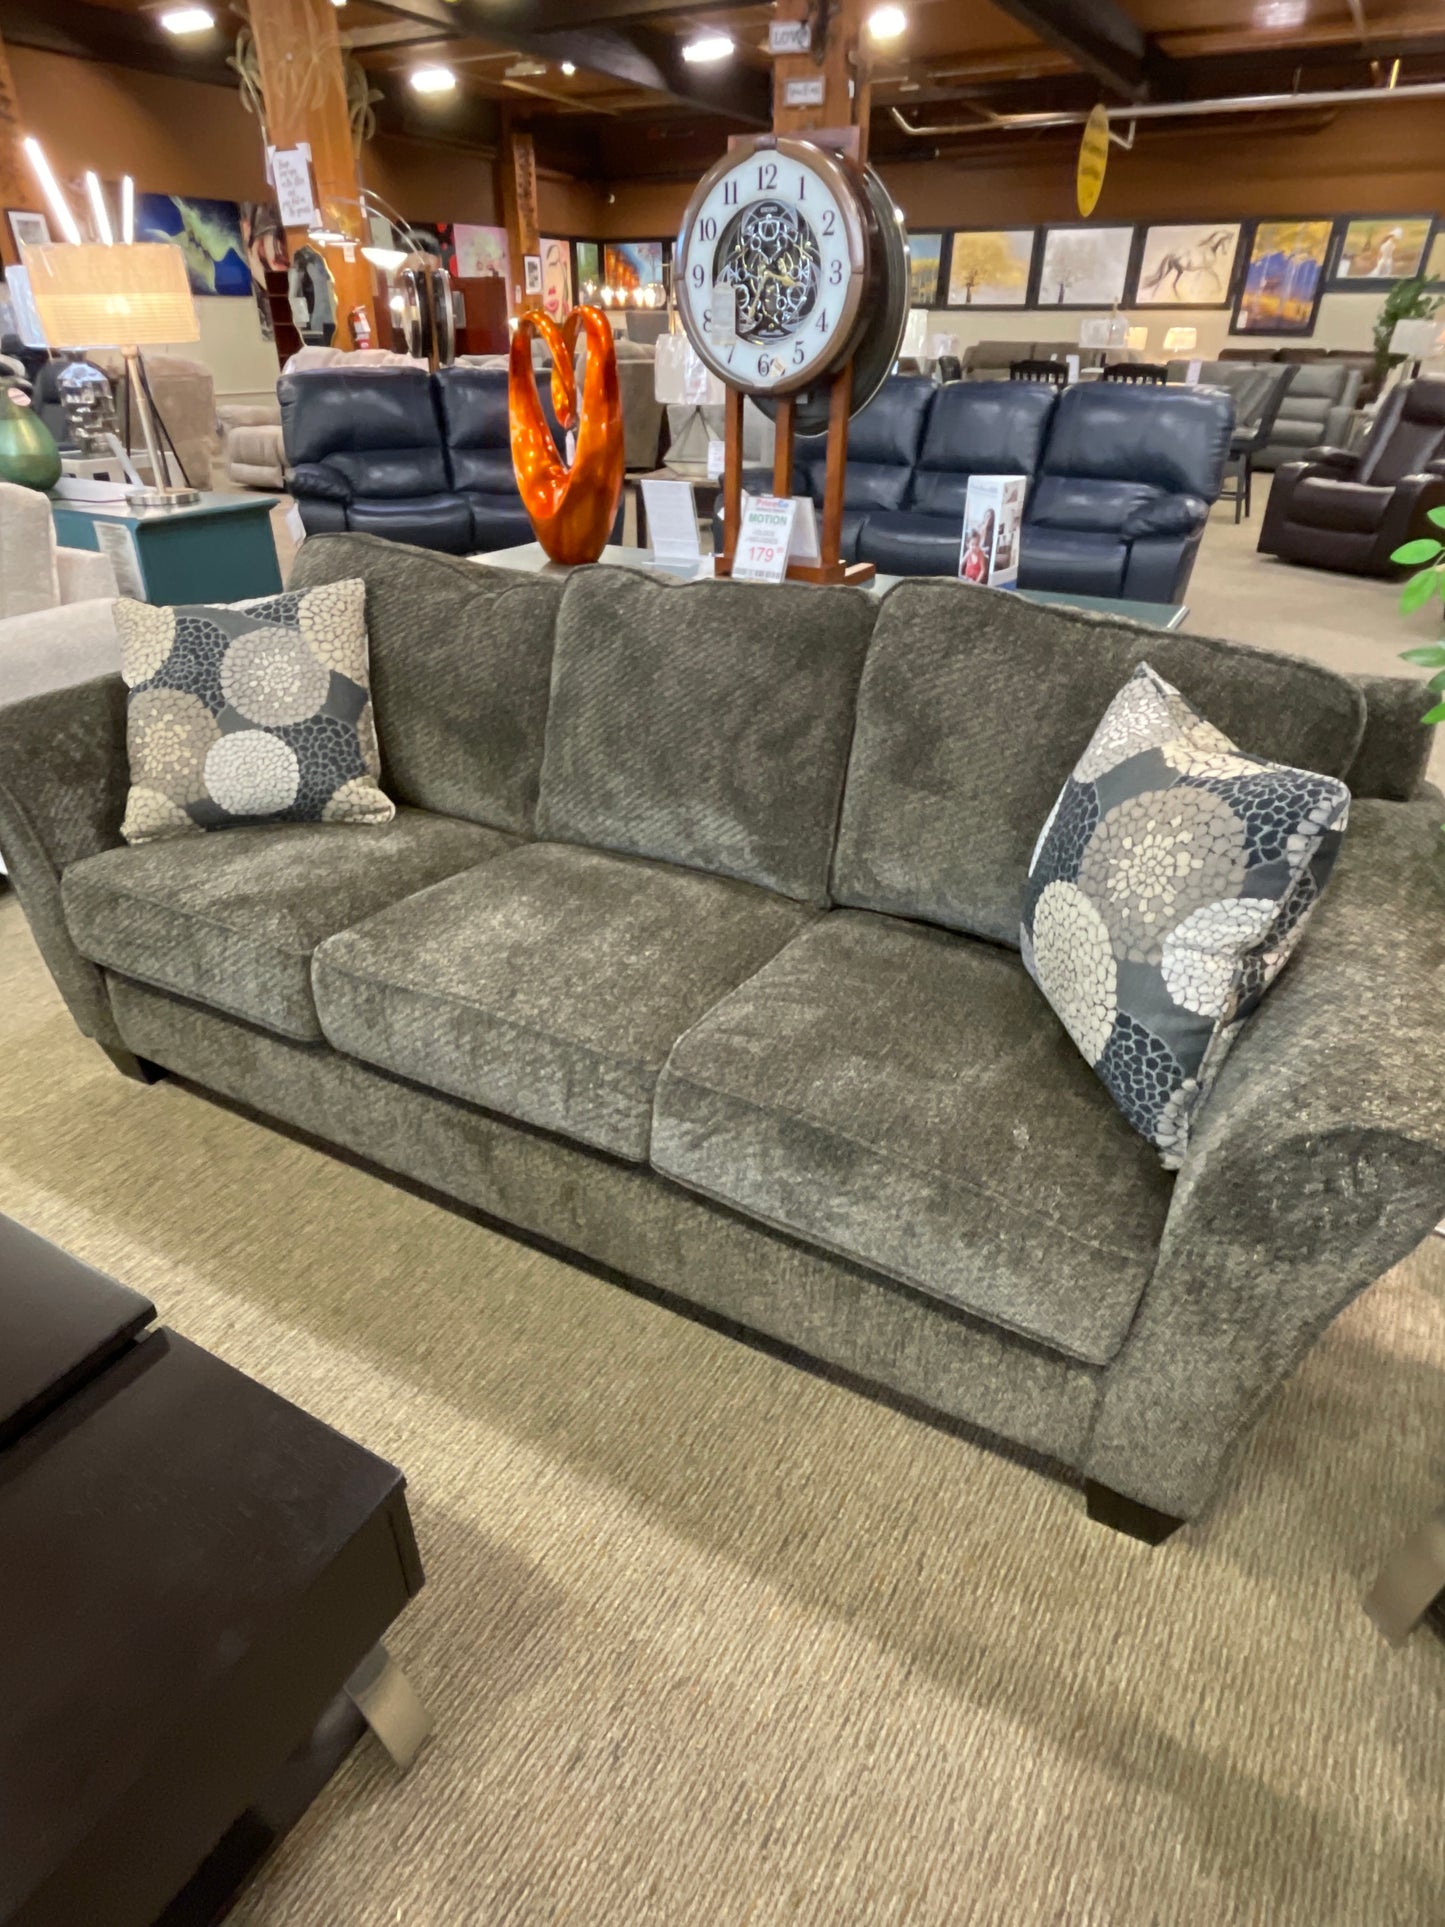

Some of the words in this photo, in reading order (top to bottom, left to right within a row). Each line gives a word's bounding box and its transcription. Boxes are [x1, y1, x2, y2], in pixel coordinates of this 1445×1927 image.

[757, 163, 777, 191] 12
[799, 175, 805, 200] 1
[724, 181, 738, 205] 11
[698, 217, 717, 241] 10
[822, 210, 836, 236] 2
[692, 264, 705, 288] 9
[829, 260, 842, 285] 3
[816, 308, 829, 333] 4
[725, 345, 736, 364] 7
[757, 353, 770, 377] 6
[792, 341, 805, 365] 5
[748, 513, 787, 526] MOTION
[748, 546, 775, 563] 179
